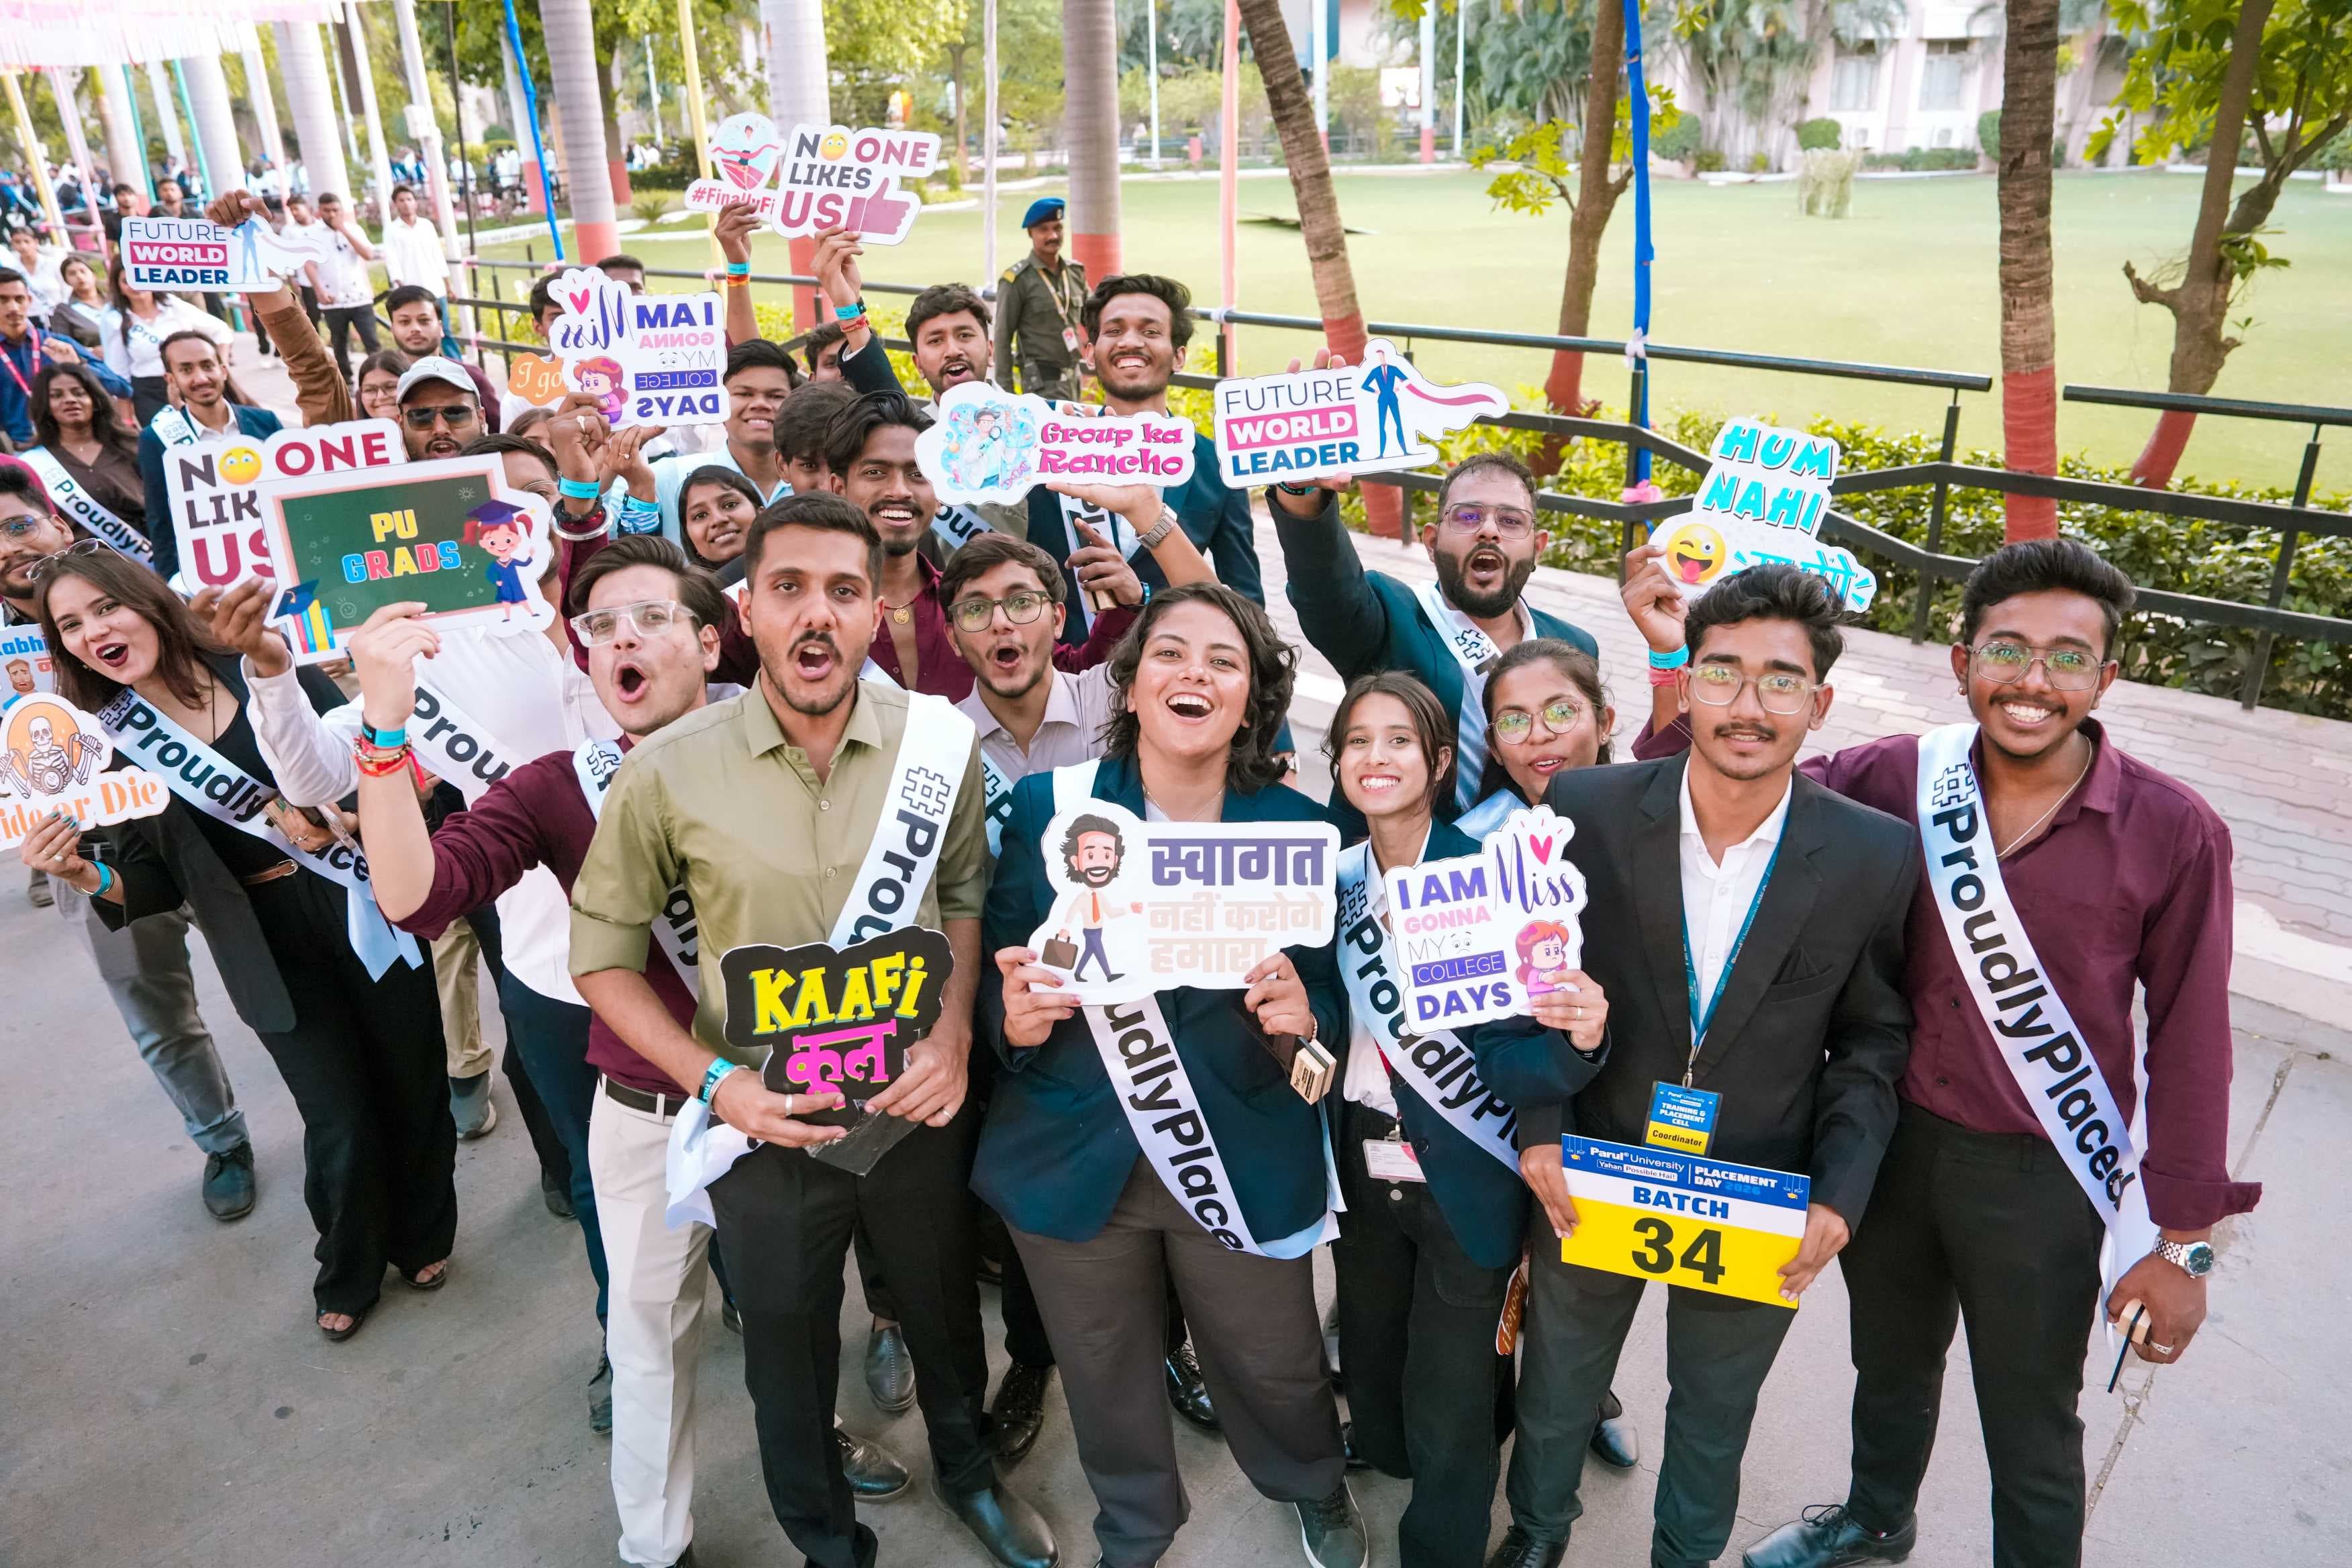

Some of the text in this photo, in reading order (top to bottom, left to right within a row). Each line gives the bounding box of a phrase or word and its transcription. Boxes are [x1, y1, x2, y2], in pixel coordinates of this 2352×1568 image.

[855, 138, 930, 167] ONE
[789, 163, 872, 189] LIKES
[130, 222, 226, 241] FUTURE
[133, 245, 225, 262] WORLD
[134, 267, 230, 284] LEADER
[1225, 377, 1355, 414] FUTURE
[1041, 422, 1183, 448] Group ka
[1230, 411, 1353, 445] WORLD
[275, 432, 389, 476] ONE
[1036, 448, 1183, 475] Rancho
[1232, 442, 1360, 476] LEADER
[1718, 426, 1834, 479] HUM
[1702, 471, 1823, 536] NAHI
[370, 509, 418, 543] PU
[342, 540, 462, 584] GRADS
[100, 776, 158, 815] Die
[1148, 838, 1328, 886] स्वागत
[1495, 833, 1574, 914] Miss
[1398, 867, 1487, 910] I AM
[1148, 891, 1324, 932] नहीं करोगे
[1404, 905, 1491, 934] GONNA
[1408, 936, 1445, 962] MY
[1417, 954, 1503, 983] COLLEGE
[1416, 981, 1512, 1021] DAYS
[1932, 762, 2135, 1212] #ProudlyPlaced
[786, 1018, 897, 1112] कूल
[1659, 1109, 1706, 1123] PLACEMENT
[1661, 1102, 1698, 1116] TRAINING
[1672, 1118, 1689, 1127] CELL
[1653, 1130, 1702, 1146] Coordinator
[1599, 1161, 1622, 1171] Yahan
[1626, 1166, 1657, 1177] Possible
[1630, 1154, 1685, 1173] University
[1694, 1165, 1777, 1188] PLACEMENT
[1694, 1176, 1761, 1195] DAY 2026
[1633, 1186, 1729, 1219] BATCH
[1632, 1217, 1726, 1285] 34
